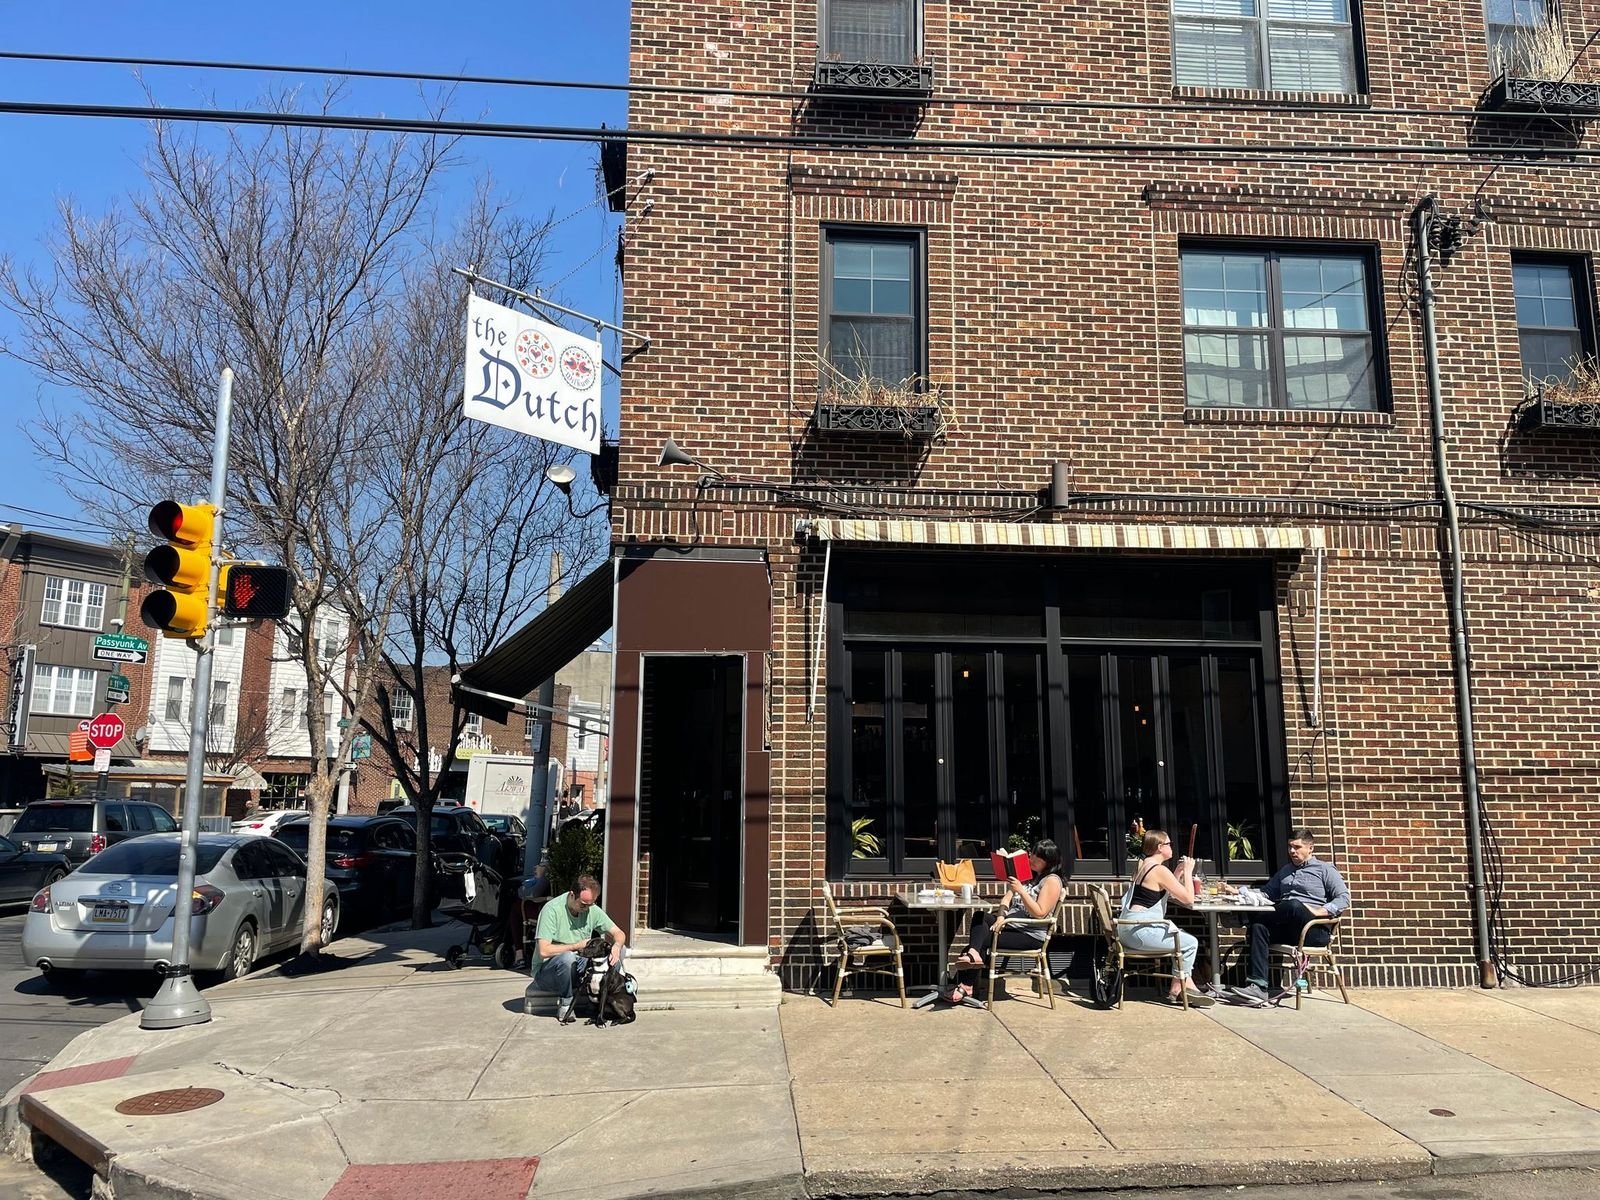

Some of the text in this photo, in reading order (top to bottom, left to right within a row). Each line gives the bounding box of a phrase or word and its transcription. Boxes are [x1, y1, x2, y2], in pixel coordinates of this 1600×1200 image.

[472, 316, 508, 347] the
[471, 348, 599, 442] Dutch
[96, 636, 148, 650] Passyunk Av
[91, 724, 122, 737] STOP
